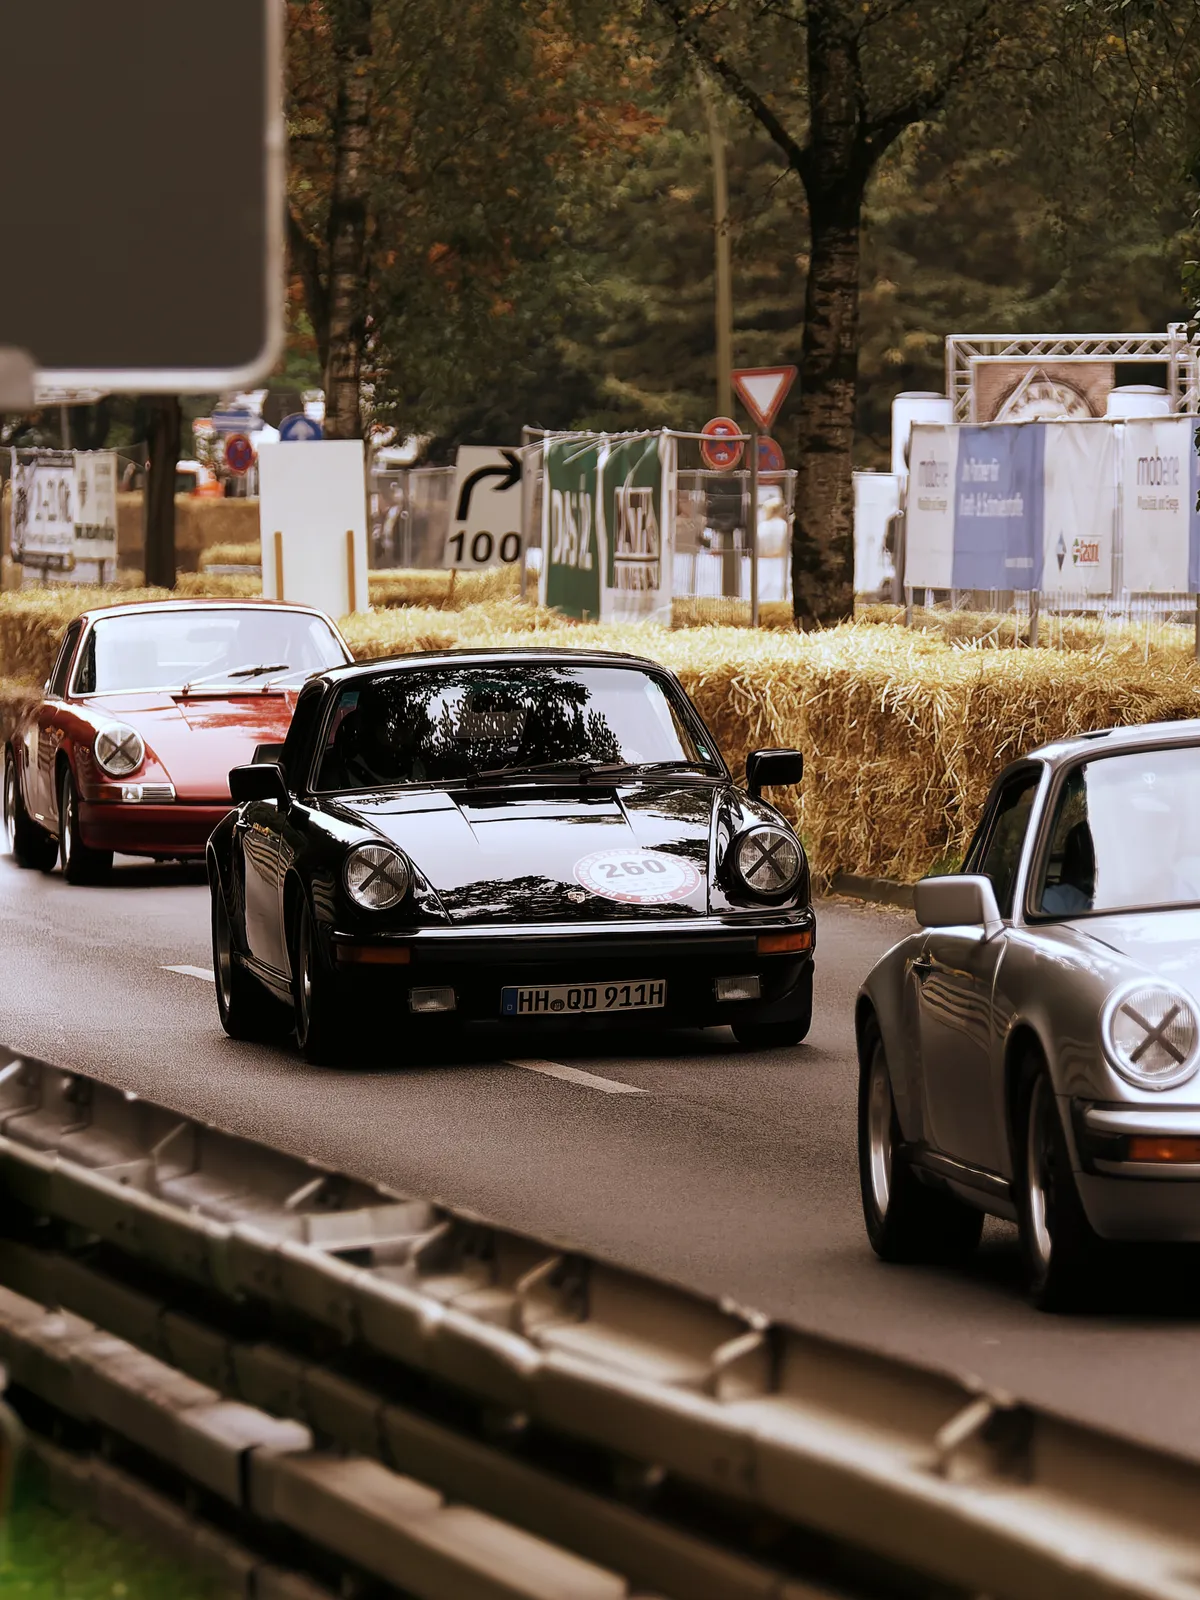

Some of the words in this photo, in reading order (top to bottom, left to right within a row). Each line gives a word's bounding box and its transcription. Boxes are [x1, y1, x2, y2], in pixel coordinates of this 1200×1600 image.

[449, 530, 521, 563] 100
[598, 859, 667, 879] 260
[519, 990, 550, 1013] HH
[567, 988, 597, 1010] QD
[604, 983, 664, 1009] 911H
